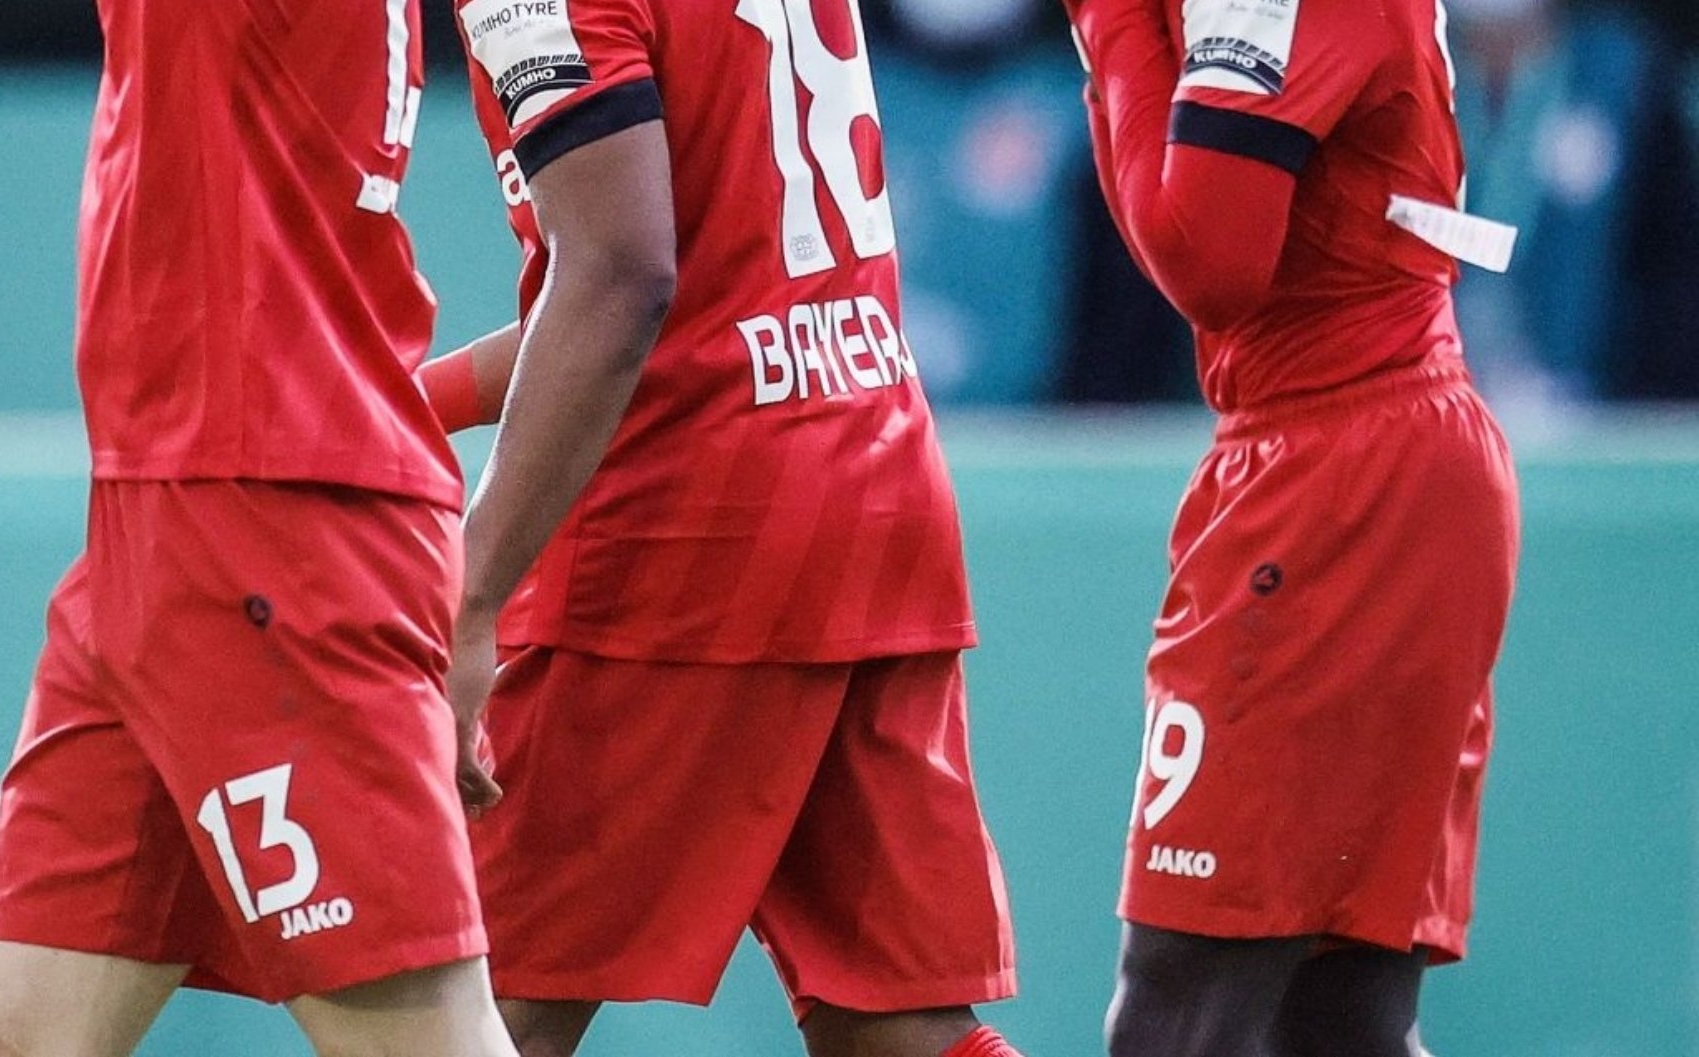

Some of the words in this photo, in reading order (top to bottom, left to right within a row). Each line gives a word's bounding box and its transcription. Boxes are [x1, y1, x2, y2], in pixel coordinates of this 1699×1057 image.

[512, 0, 558, 18] TYRE
[1193, 49, 1258, 70] KUMHO
[505, 67, 557, 100] KUMHO
[1129, 699, 1205, 831] 9
[197, 763, 319, 924] 13
[1146, 845, 1217, 878] JAKO
[279, 896, 354, 940] JAKO
